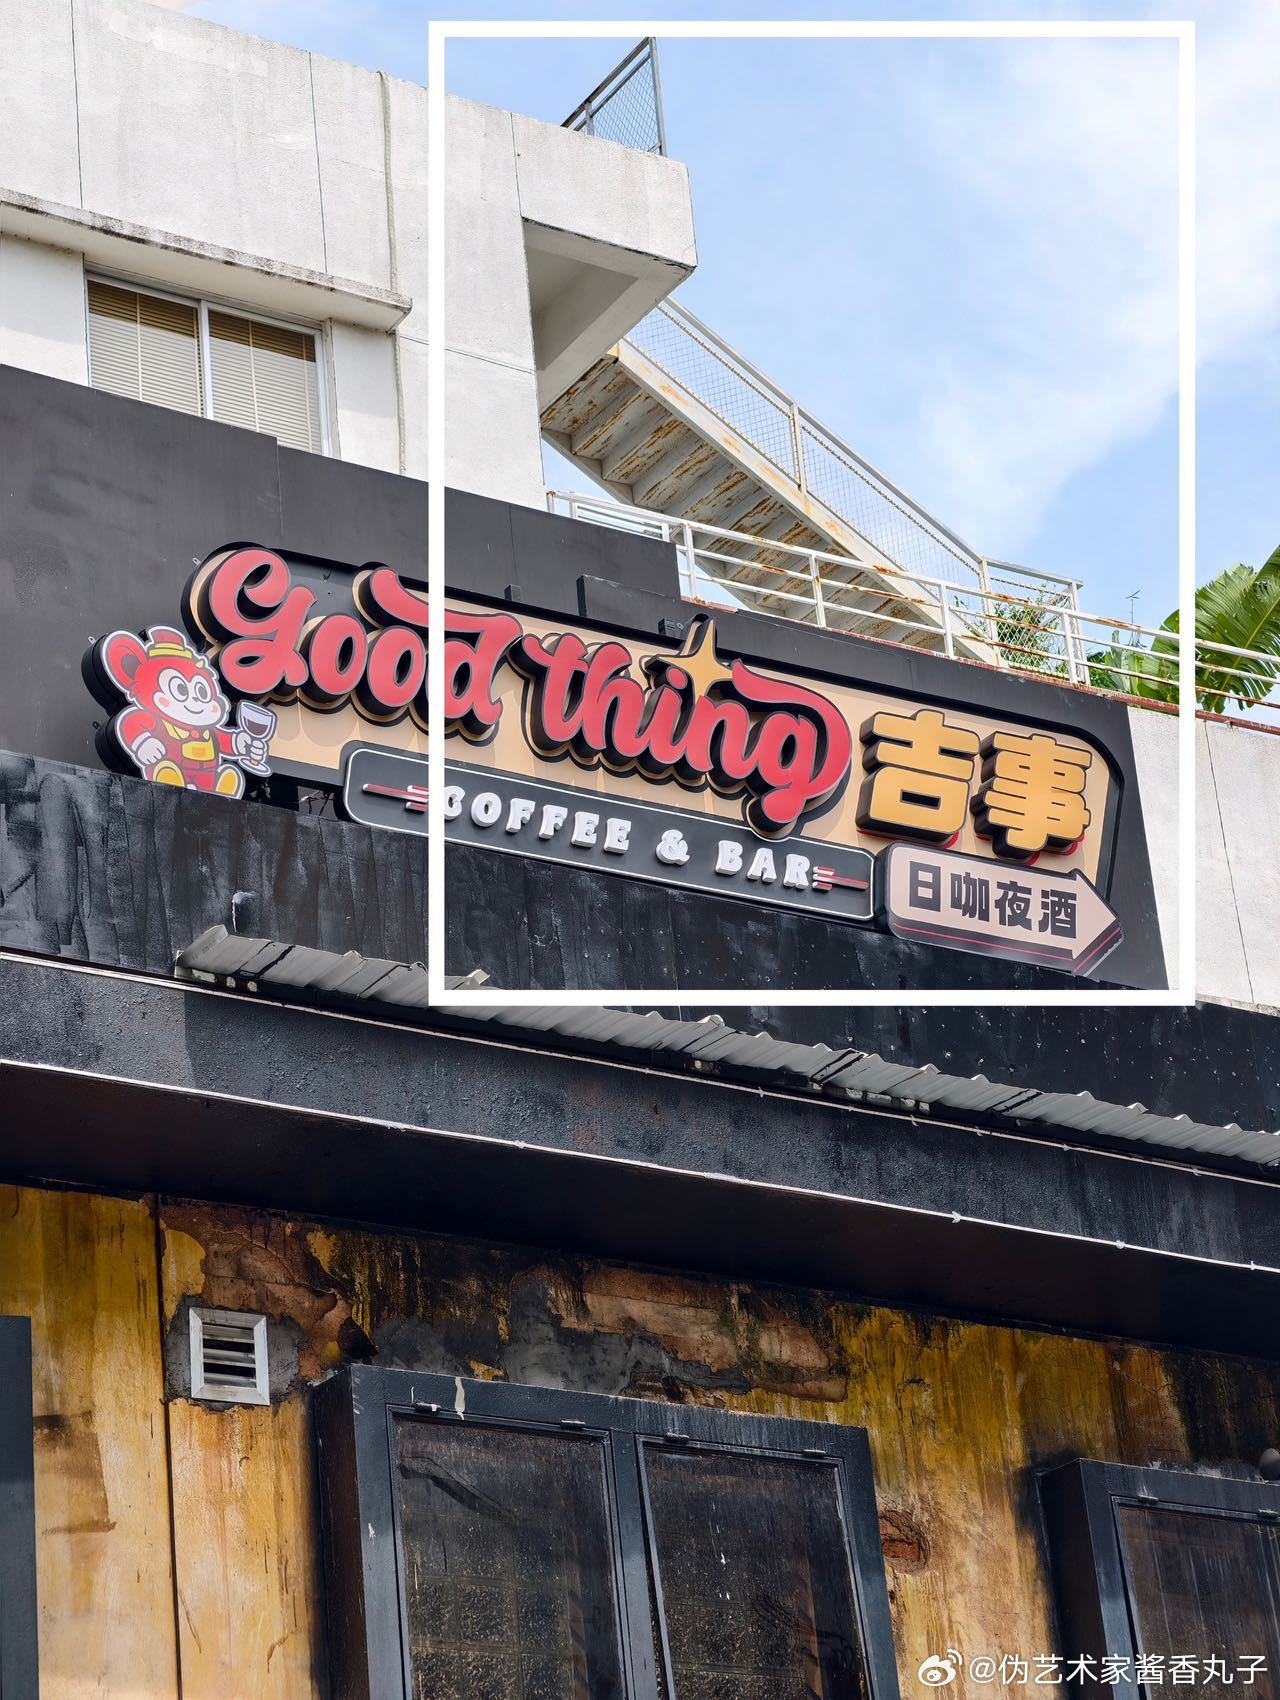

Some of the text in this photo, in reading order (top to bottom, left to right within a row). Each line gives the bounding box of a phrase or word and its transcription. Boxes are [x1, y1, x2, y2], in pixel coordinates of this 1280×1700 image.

[870, 710, 1093, 852] 吉事
[444, 786, 811, 890] COFFEE & BAR
[909, 861, 1077, 939] 日咖夜酒
